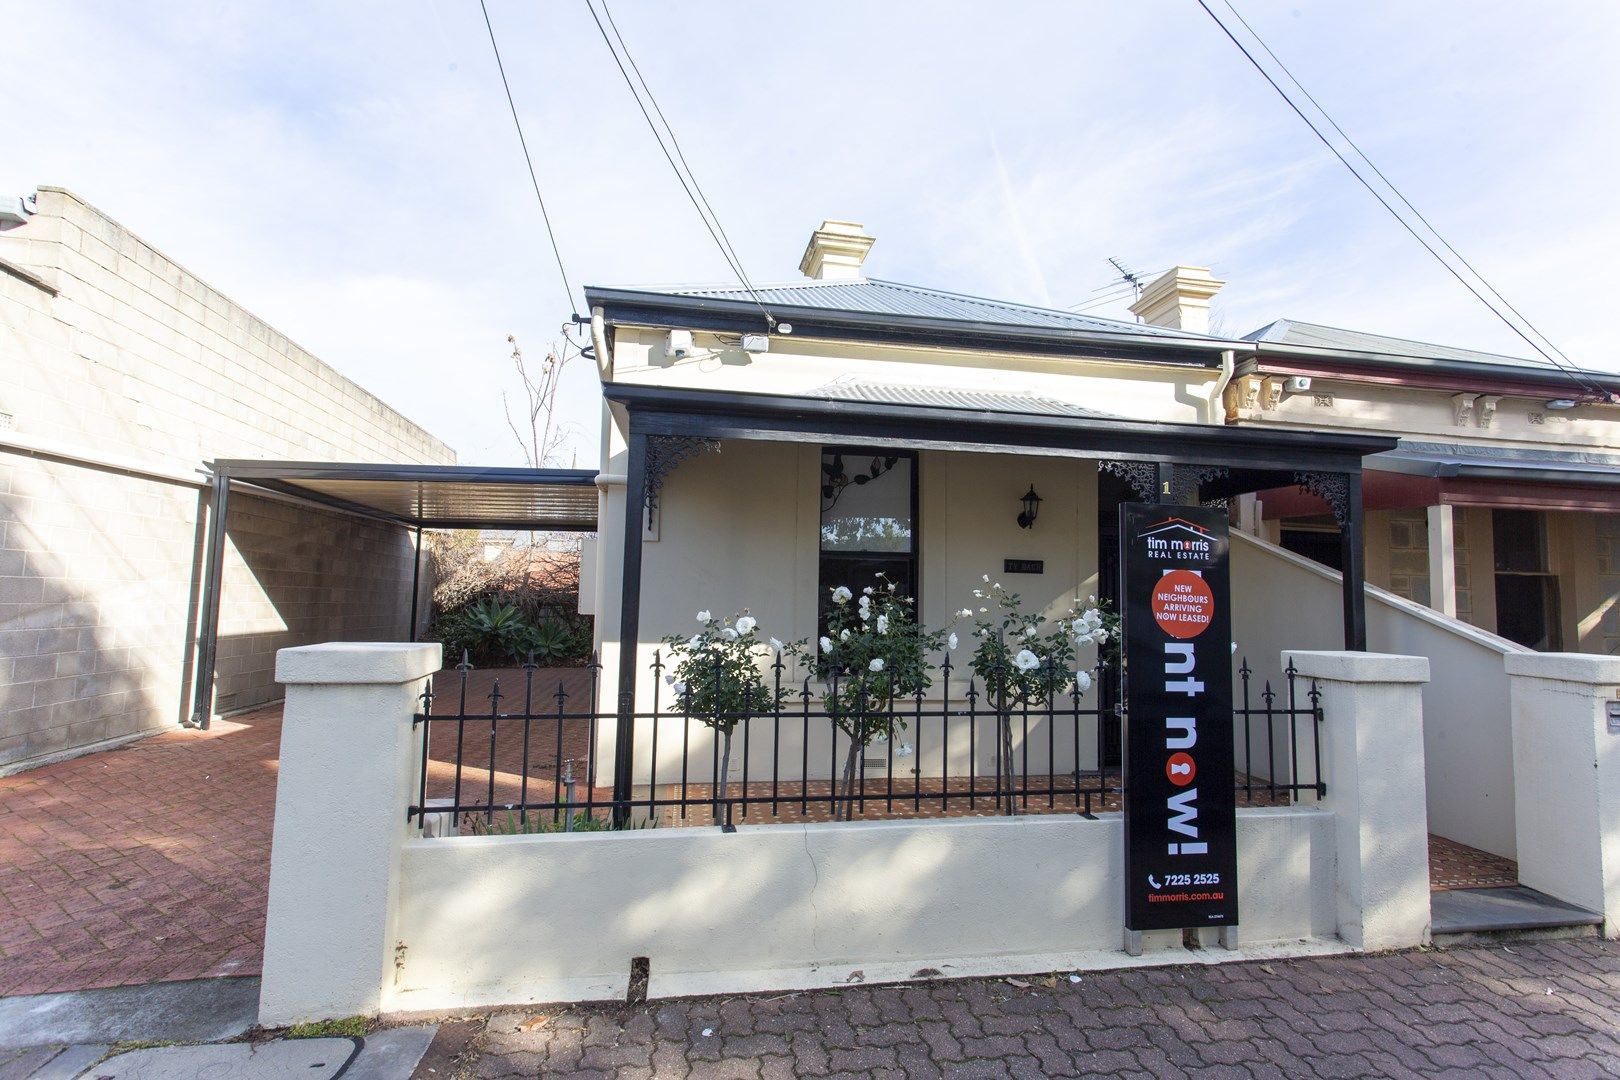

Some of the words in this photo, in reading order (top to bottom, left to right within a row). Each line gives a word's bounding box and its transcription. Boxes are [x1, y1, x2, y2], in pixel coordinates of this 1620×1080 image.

[1162, 481, 1171, 495] 1
[1147, 536, 1167, 550] tim
[1171, 539, 1209, 551] morris
[1148, 551, 1172, 559] REAL
[1177, 552, 1210, 560] ESTATE
[1174, 584, 1193, 592] NEW
[1157, 593, 1209, 604] NEIGHBOURS
[1163, 603, 1203, 613] ARRIVING
[1156, 612, 1177, 621] NOW
[1179, 613, 1209, 624] LEASED!
[1164, 874, 1191, 886] 7225
[1193, 873, 1220, 885] 2525
[1148, 891, 1224, 903] timmorris.com.au
